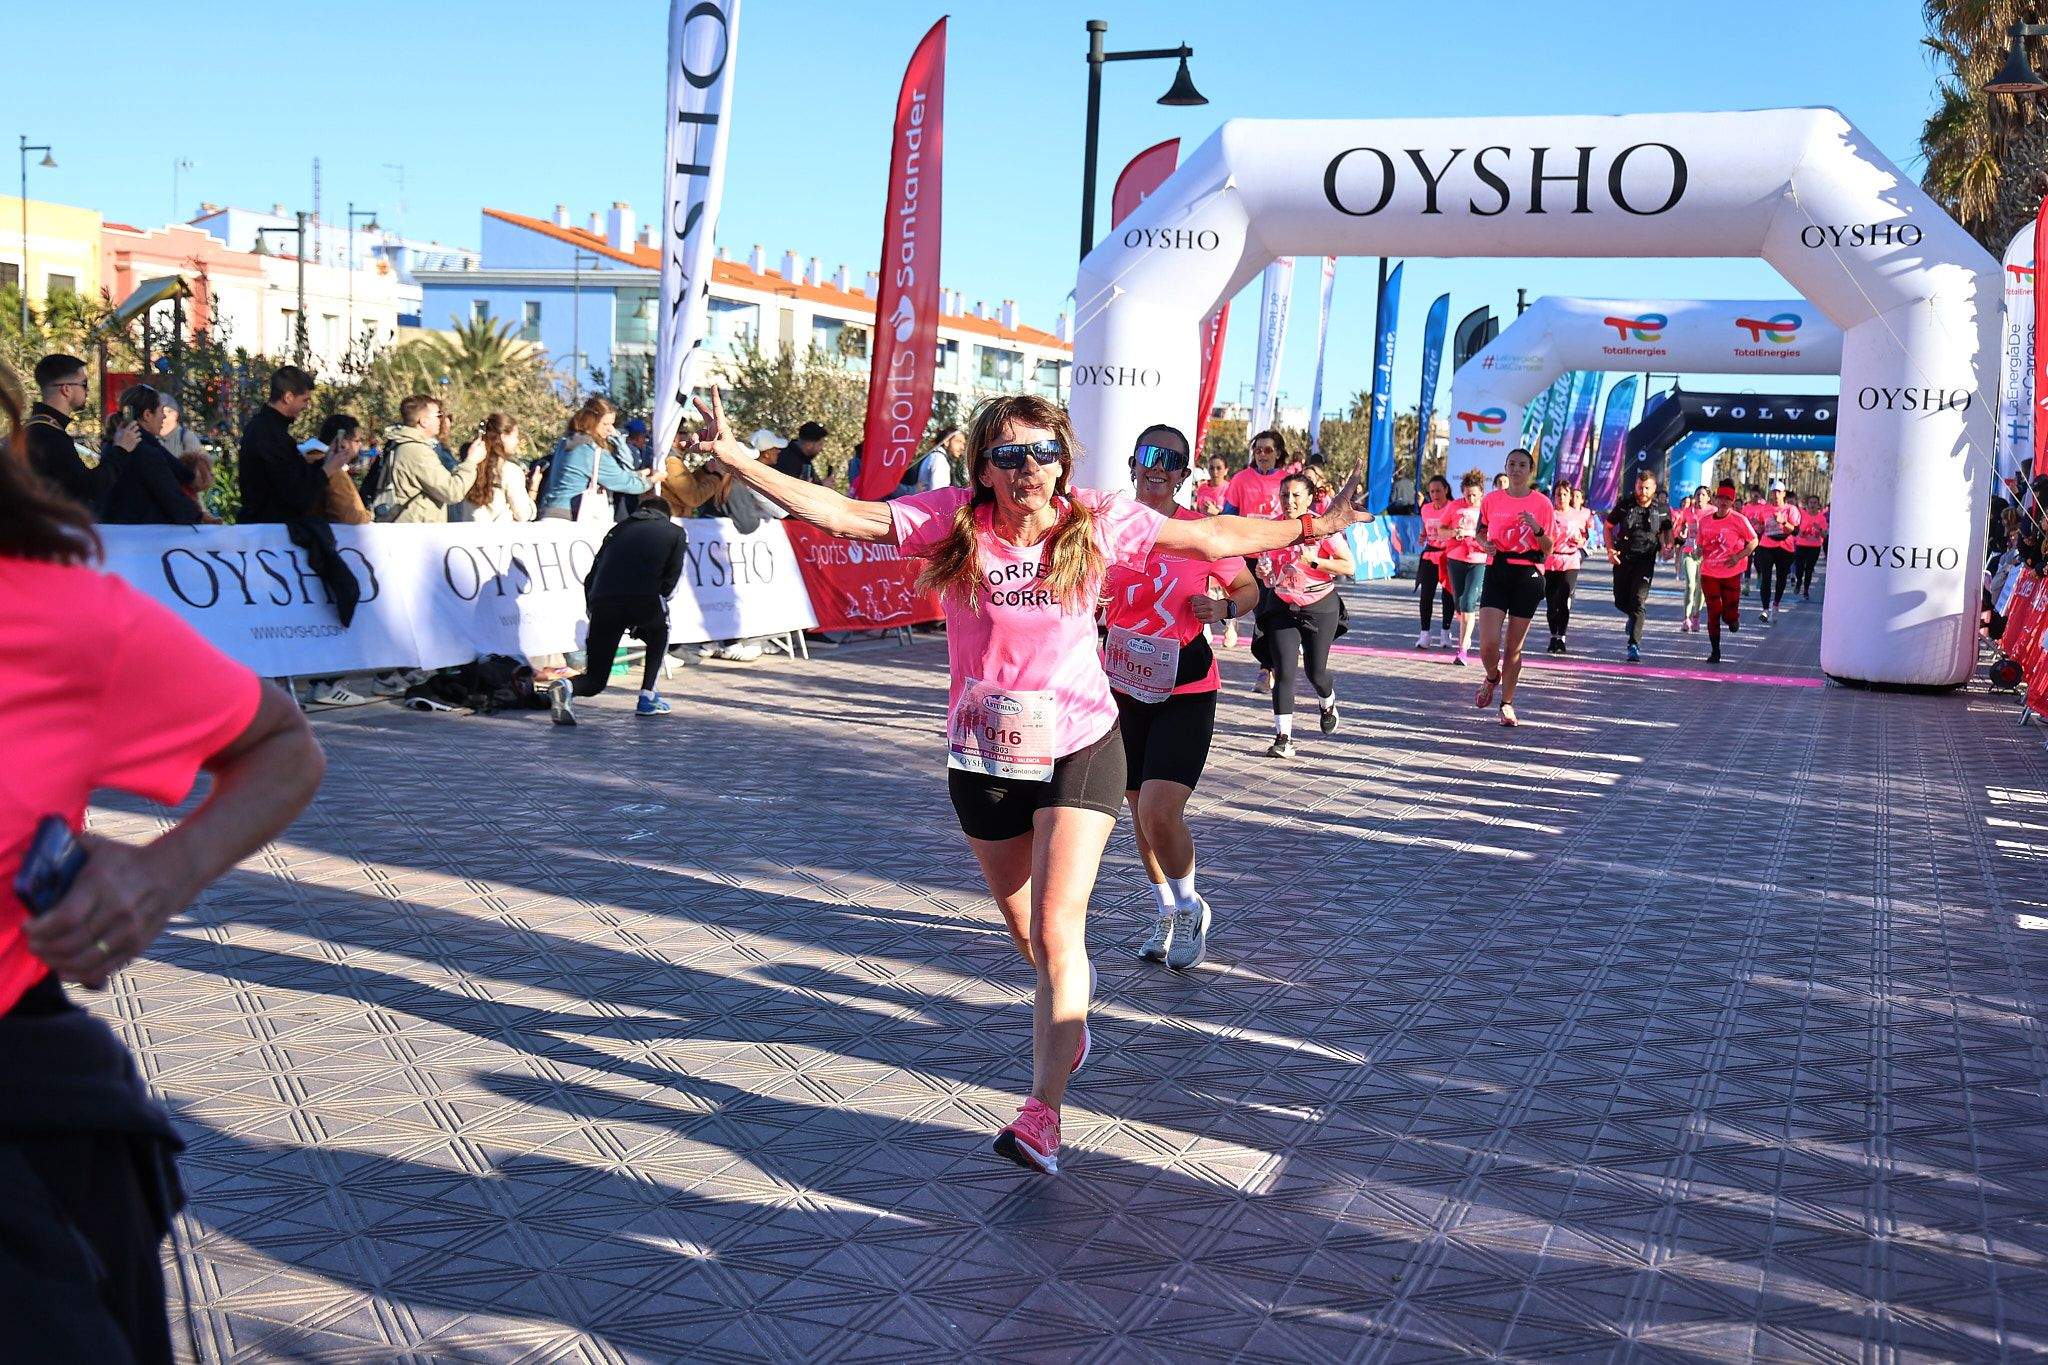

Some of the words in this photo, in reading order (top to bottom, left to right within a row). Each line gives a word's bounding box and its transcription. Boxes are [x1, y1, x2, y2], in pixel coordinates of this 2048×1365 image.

[896, 88, 927, 288] Santander
[1323, 142, 1689, 217] OYSHO
[1124, 228, 1219, 250] OYSHO
[1801, 223, 1922, 249] OYSHO
[2005, 287, 2034, 297] TotalEner
[1603, 346, 1667, 357] TotalEnergies
[1734, 348, 1801, 360] TotalEnergies
[1076, 365, 1161, 387] OYSHO
[883, 350, 915, 467] Sports
[1858, 386, 1972, 412] OYSHO
[1702, 405, 1830, 422] VOLVO
[1456, 437, 1505, 449] TotalEnergies
[687, 540, 774, 588] YSHO
[800, 536, 848, 570] Sports
[1847, 542, 1959, 571] OYSHO
[161, 547, 379, 609] OYSHO
[444, 539, 597, 601] OYSHO
[1126, 660, 1153, 678] 016
[984, 699, 1020, 713] ASTURIANA
[984, 726, 1022, 745] 016
[991, 745, 1009, 754] 4903
[960, 757, 992, 768] OYSHO
[1010, 767, 1042, 775] Santander
